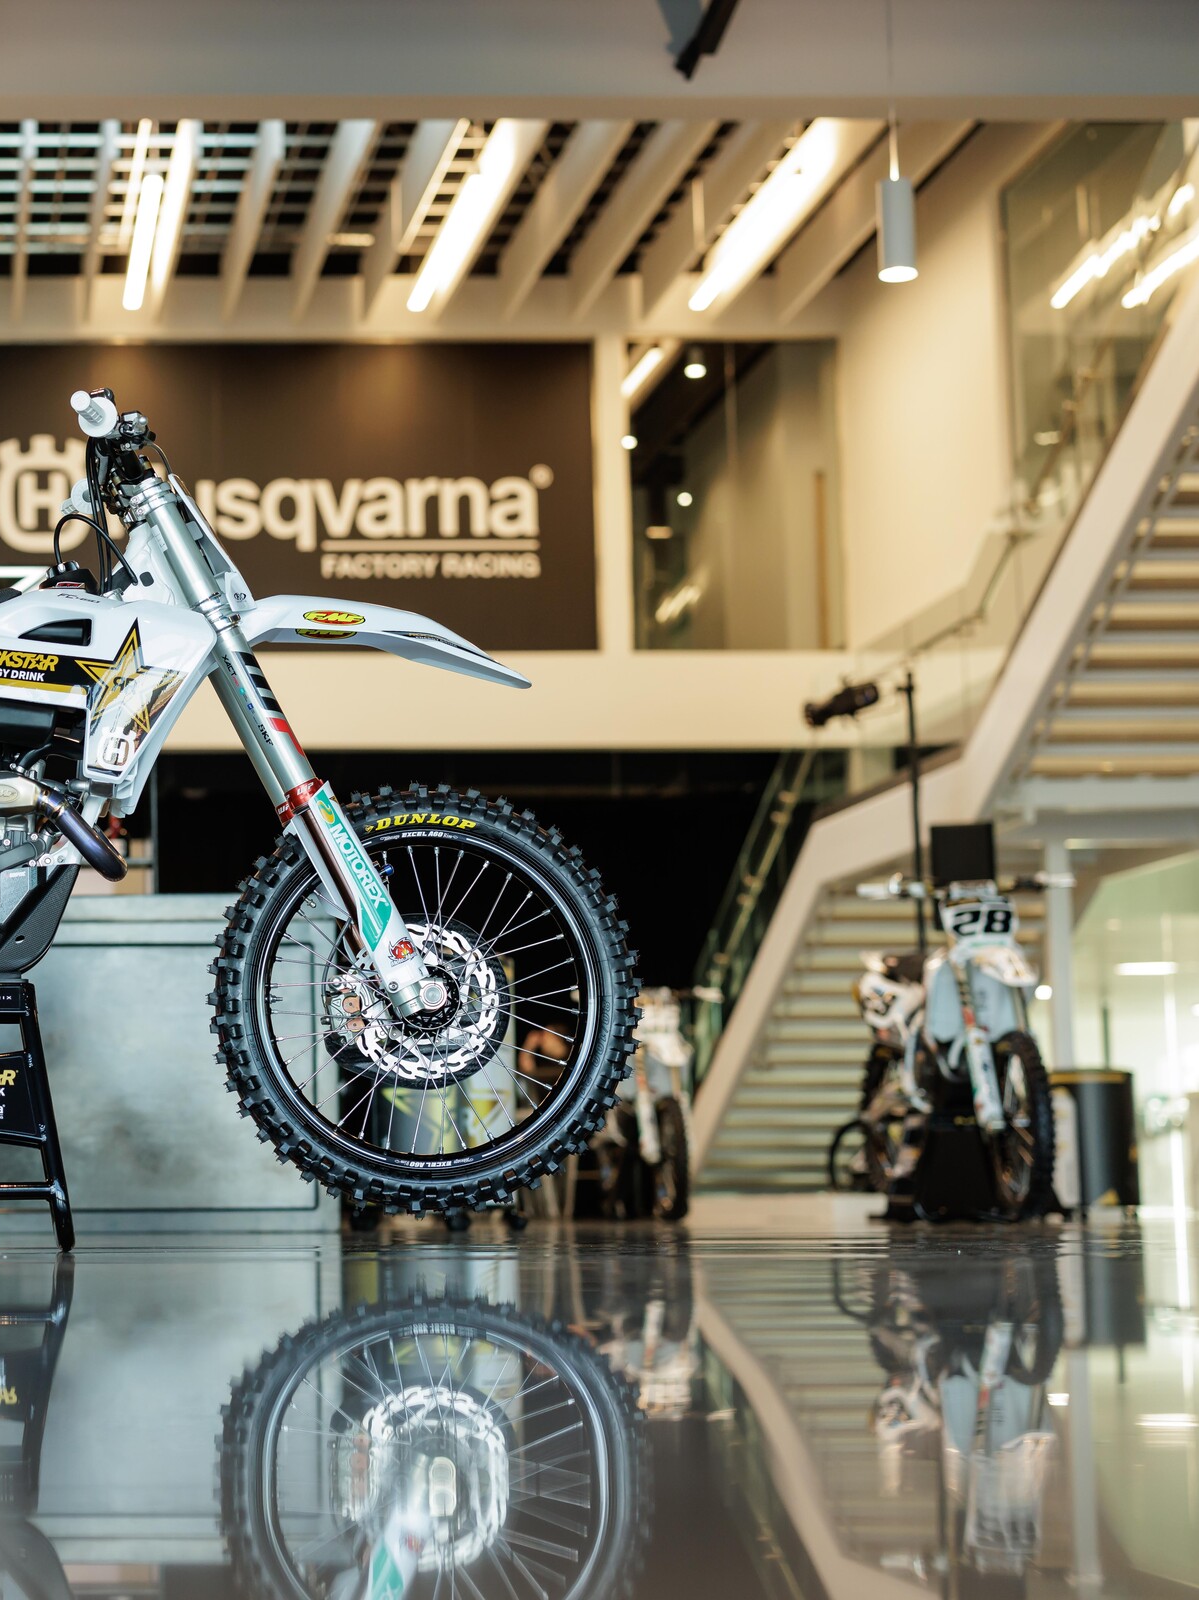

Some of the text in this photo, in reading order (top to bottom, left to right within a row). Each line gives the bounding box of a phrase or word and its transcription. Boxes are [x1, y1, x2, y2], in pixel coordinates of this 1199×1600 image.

[110, 464, 540, 553] sqvarna
[321, 553, 541, 579] FACTORY RACING
[307, 612, 365, 623] FMF
[9, 668, 45, 682] DRINK
[222, 654, 238, 676] XACT
[257, 723, 274, 746] SKF
[375, 813, 477, 831] DUNLOP
[329, 824, 388, 910] MOTOREX
[953, 910, 1012, 936] 28
